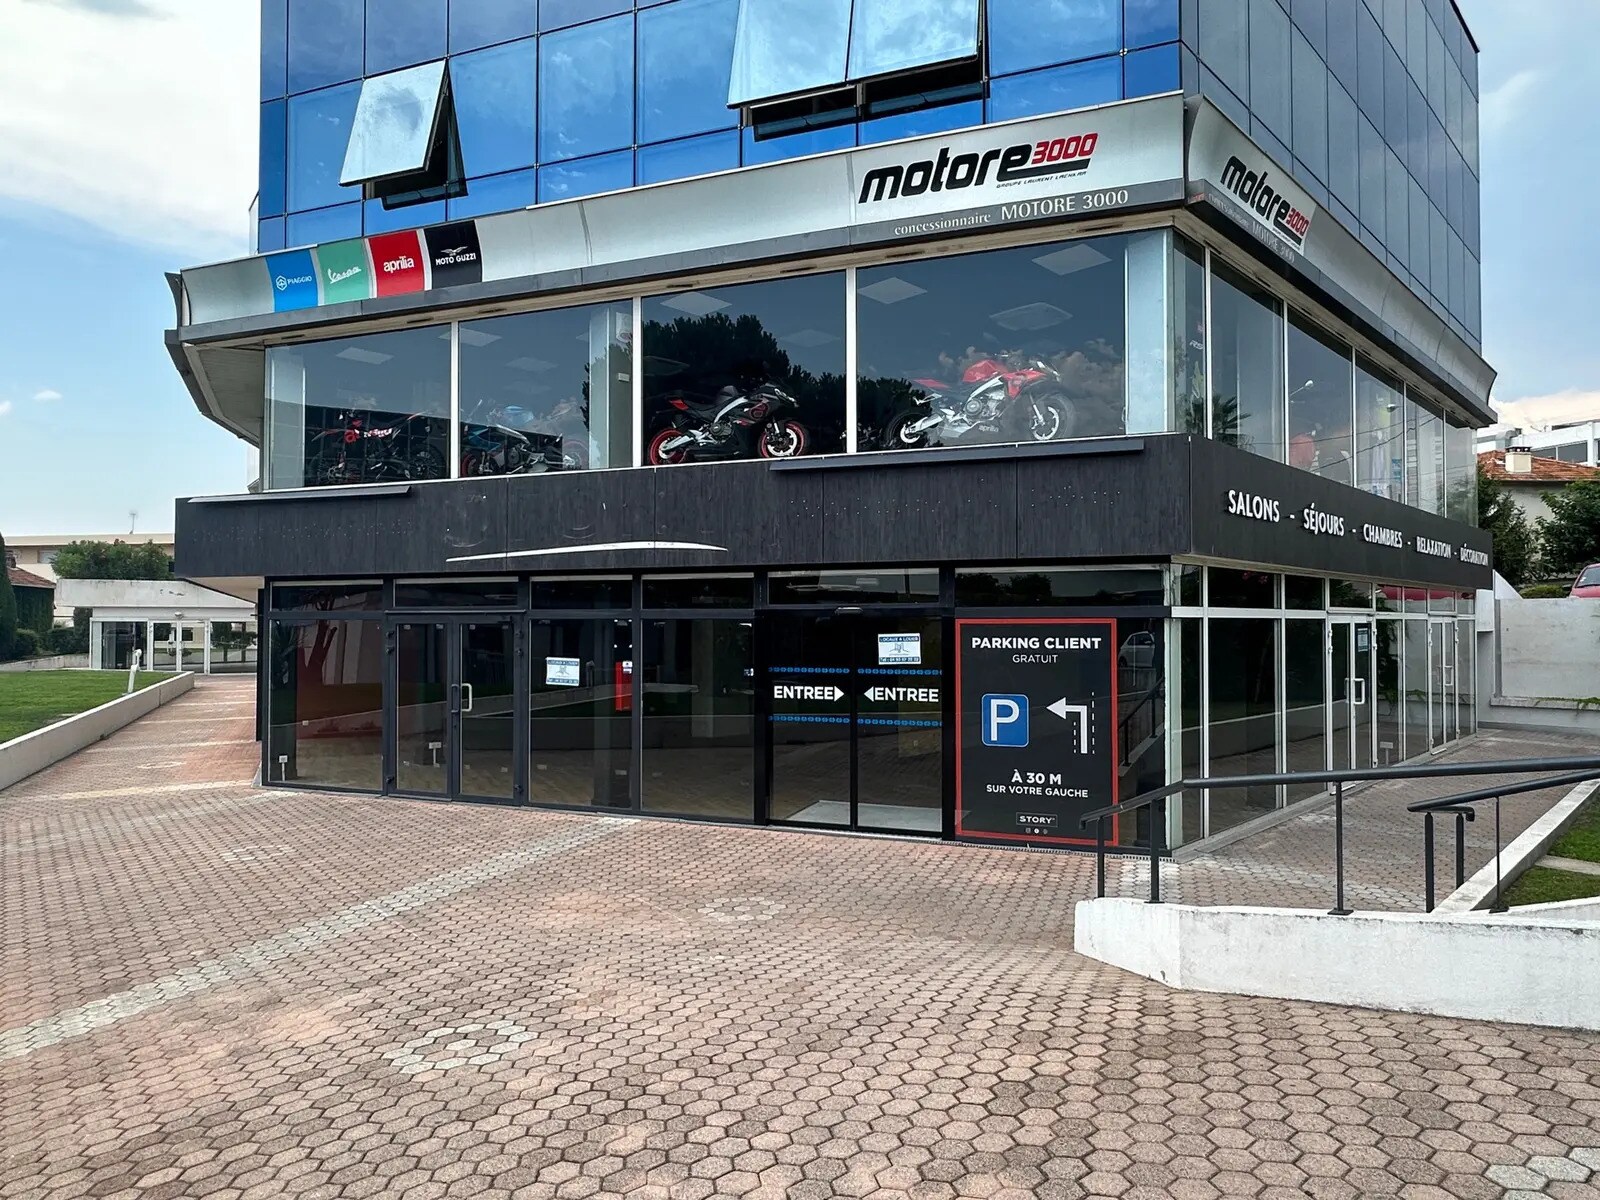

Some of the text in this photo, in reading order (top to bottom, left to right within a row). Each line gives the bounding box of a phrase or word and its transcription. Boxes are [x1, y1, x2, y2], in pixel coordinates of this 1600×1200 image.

[894, 189, 1129, 236] concessionnaire MOTORE 3000
[383, 255, 415, 274] aprilia
[435, 252, 477, 266] MOTO GUZZI
[287, 275, 313, 285] PIAGGIO
[327, 265, 362, 285] Vespa
[1228, 489, 1280, 523] SALONS
[1303, 502, 1345, 536] SÉJOURS
[1363, 523, 1403, 549] CHAMBRES
[1416, 536, 1452, 559] RELAXATION
[971, 637, 1101, 649] PARKING CLIENT
[1012, 654, 1058, 663] GRATUIT
[773, 685, 834, 700] ENTREE
[874, 687, 939, 702] ENTREE
[990, 699, 1020, 741] P
[1011, 769, 1062, 785] À 30 M
[986, 784, 1089, 798] SUR VOTRE GAUCHE
